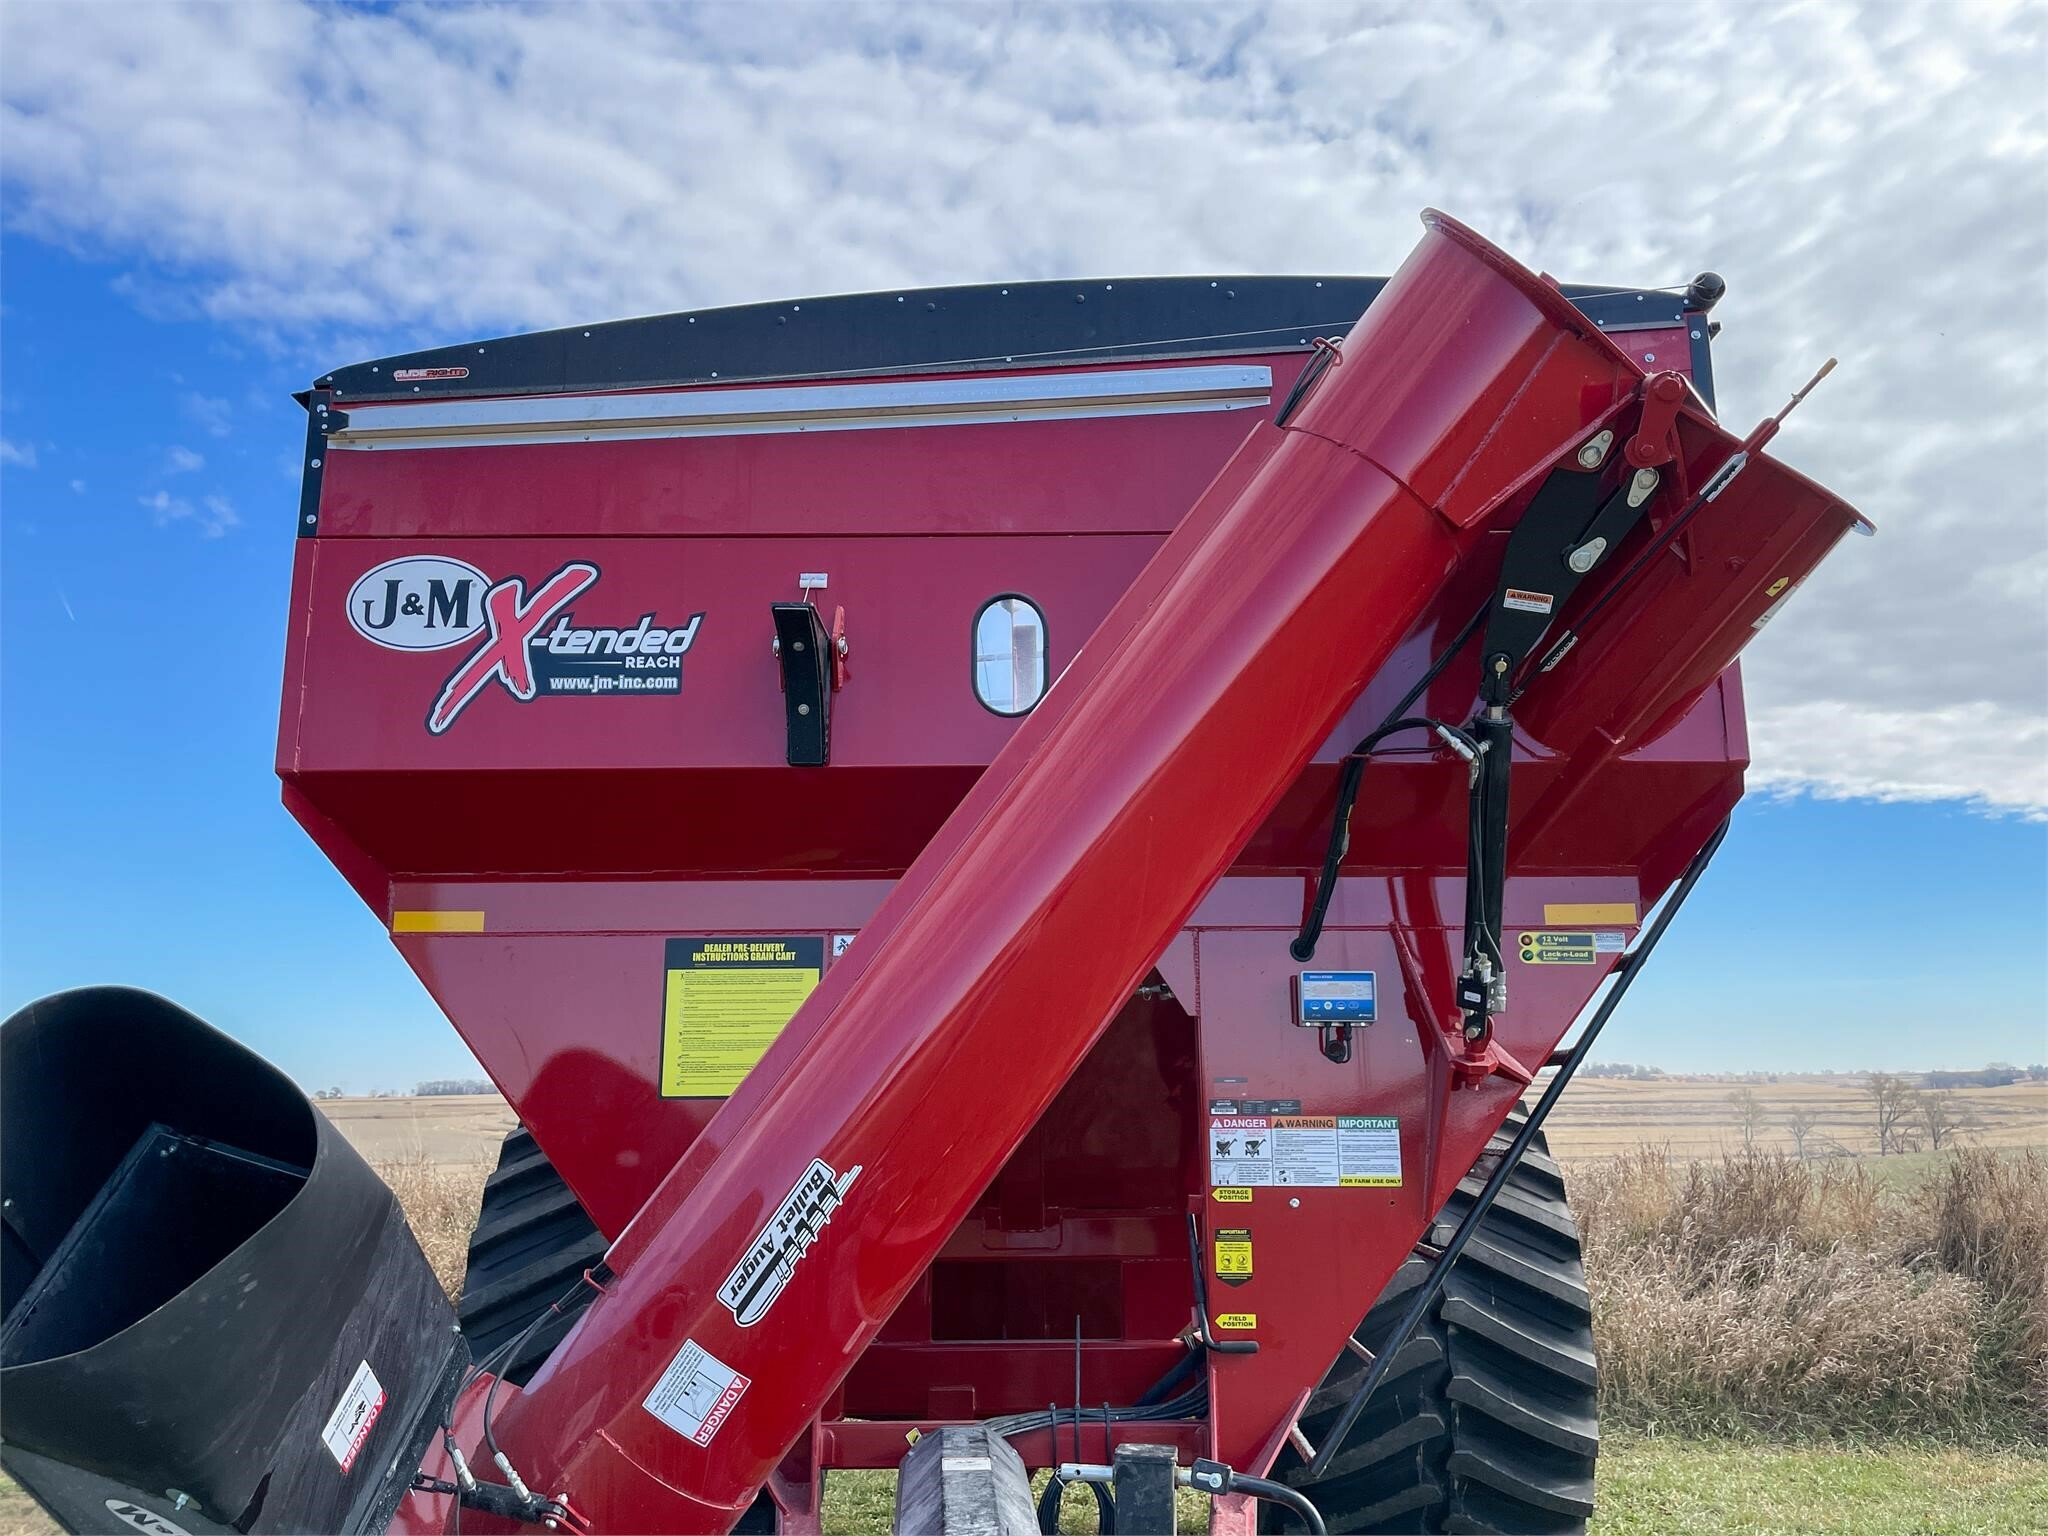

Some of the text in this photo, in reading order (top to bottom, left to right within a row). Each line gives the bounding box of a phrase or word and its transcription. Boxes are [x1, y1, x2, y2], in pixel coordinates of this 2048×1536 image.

[1517, 593, 1549, 603] WARNING
[362, 578, 474, 630] J&M
[625, 655, 680, 669] REACH
[550, 675, 678, 693] www.jm-inc.com
[1541, 935, 1569, 943] 12 Volt
[704, 943, 785, 953] DEALER PRE-DELIVERY
[692, 951, 797, 962] INSTRUCTIONS GRAIN CART
[1543, 950, 1589, 958] Lock-n-Load
[1223, 1118, 1267, 1128] DANGER
[1286, 1119, 1334, 1129] WARNING
[1338, 1119, 1398, 1128] IMPORTANT
[730, 1167, 826, 1302] Bullet Auger
[695, 1389, 738, 1443] DANGER
[343, 1409, 379, 1469] DANGER
